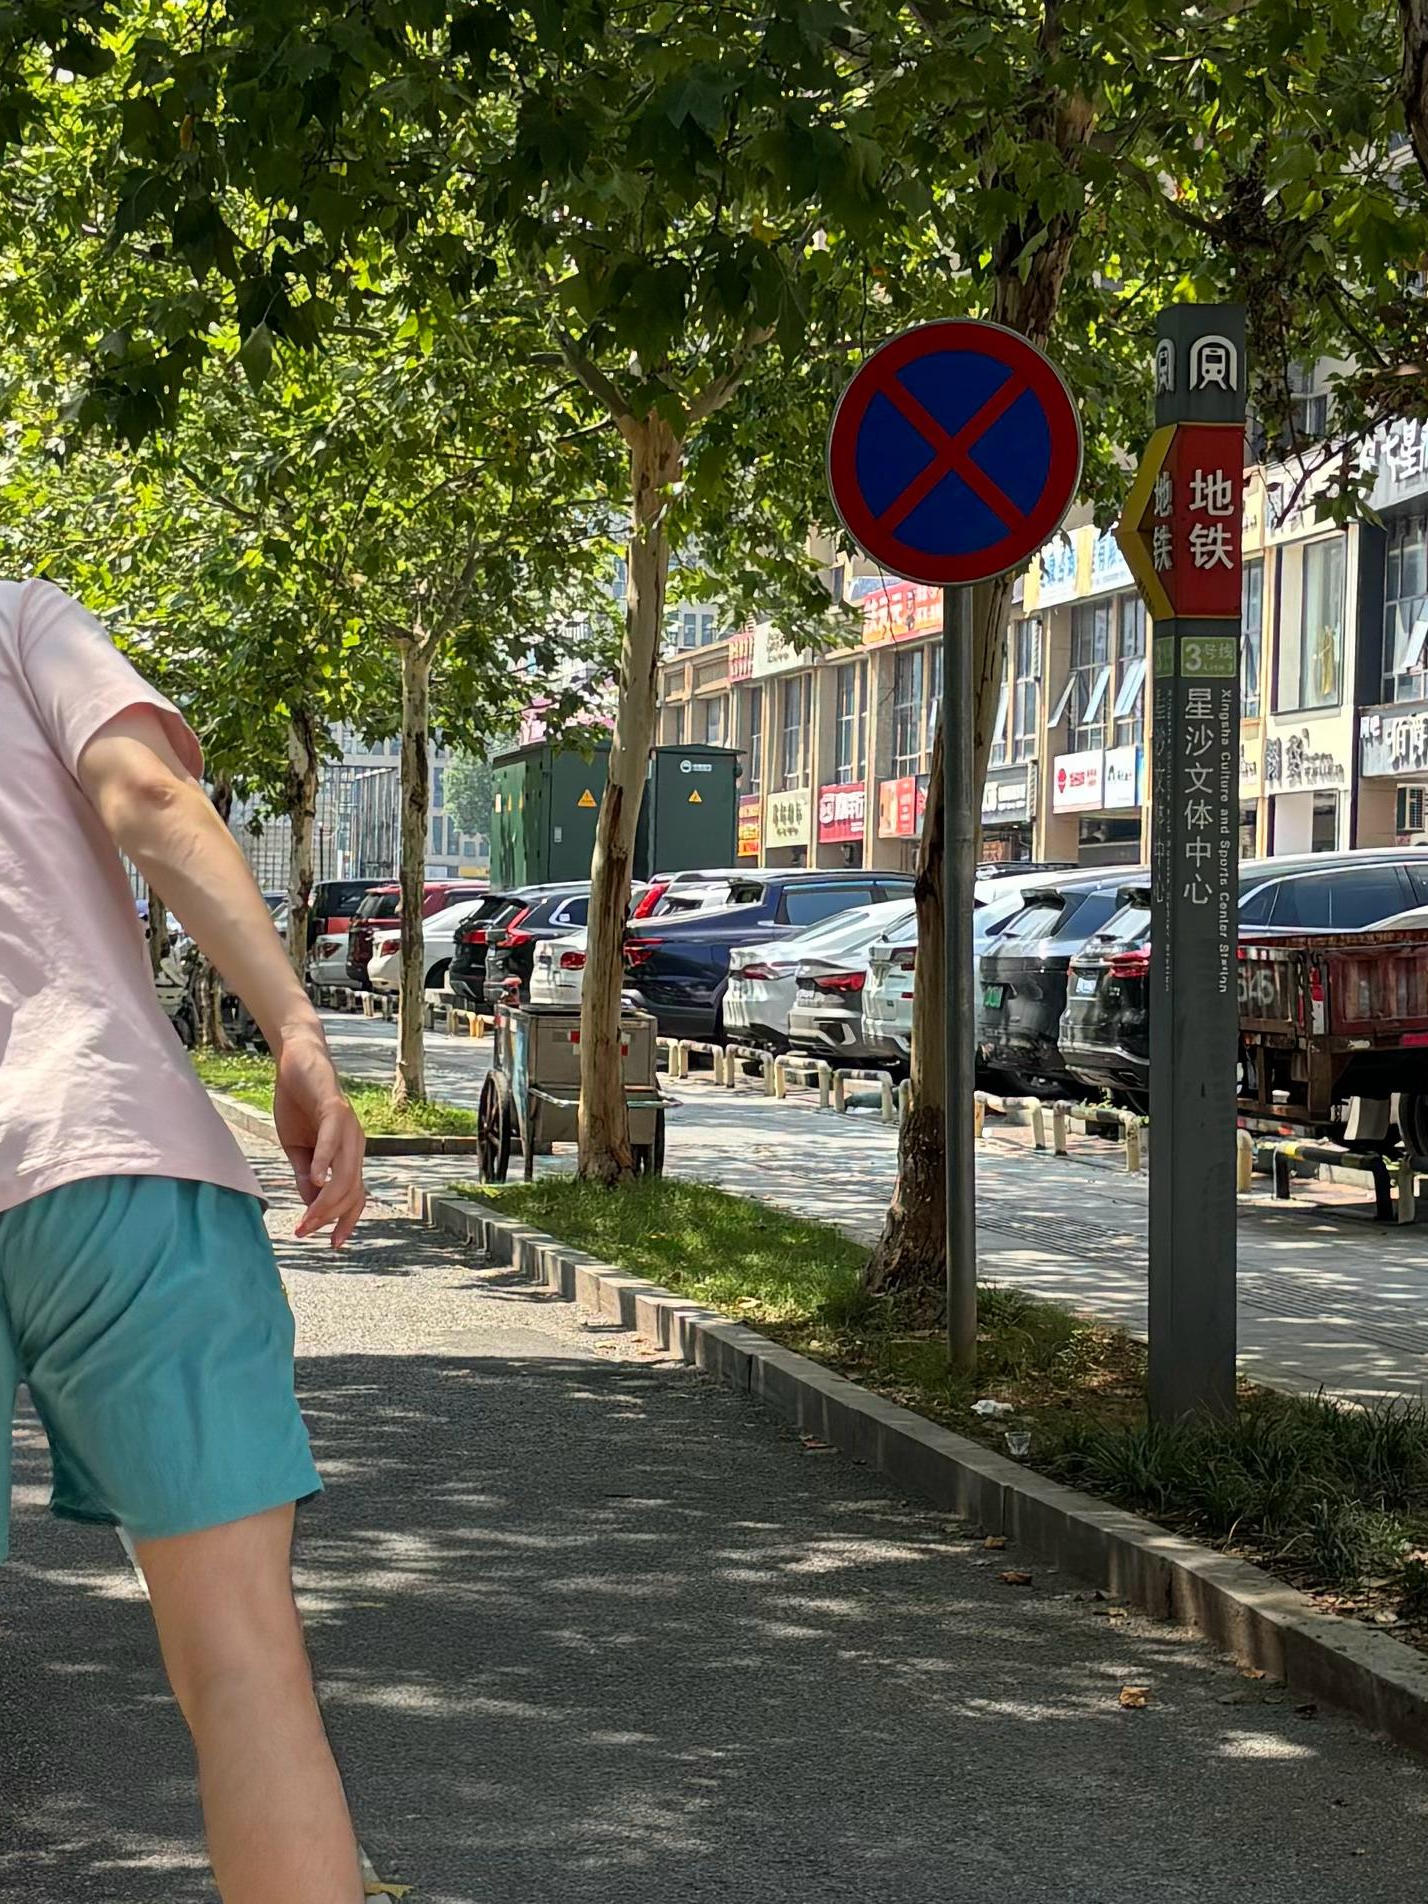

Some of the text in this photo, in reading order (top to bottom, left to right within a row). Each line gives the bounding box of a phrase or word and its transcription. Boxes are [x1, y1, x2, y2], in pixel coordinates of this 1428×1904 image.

[1153, 471, 1172, 572] 地铁
[1189, 468, 1235, 571] 地铁
[1219, 689, 1232, 745] Xingsha
[1184, 688, 1215, 905] 星沙文体中心
[1220, 752, 1232, 802] Culture
[1220, 809, 1231, 834] and
[1218, 840, 1231, 886] Sports
[1219, 892, 1230, 938] Center
